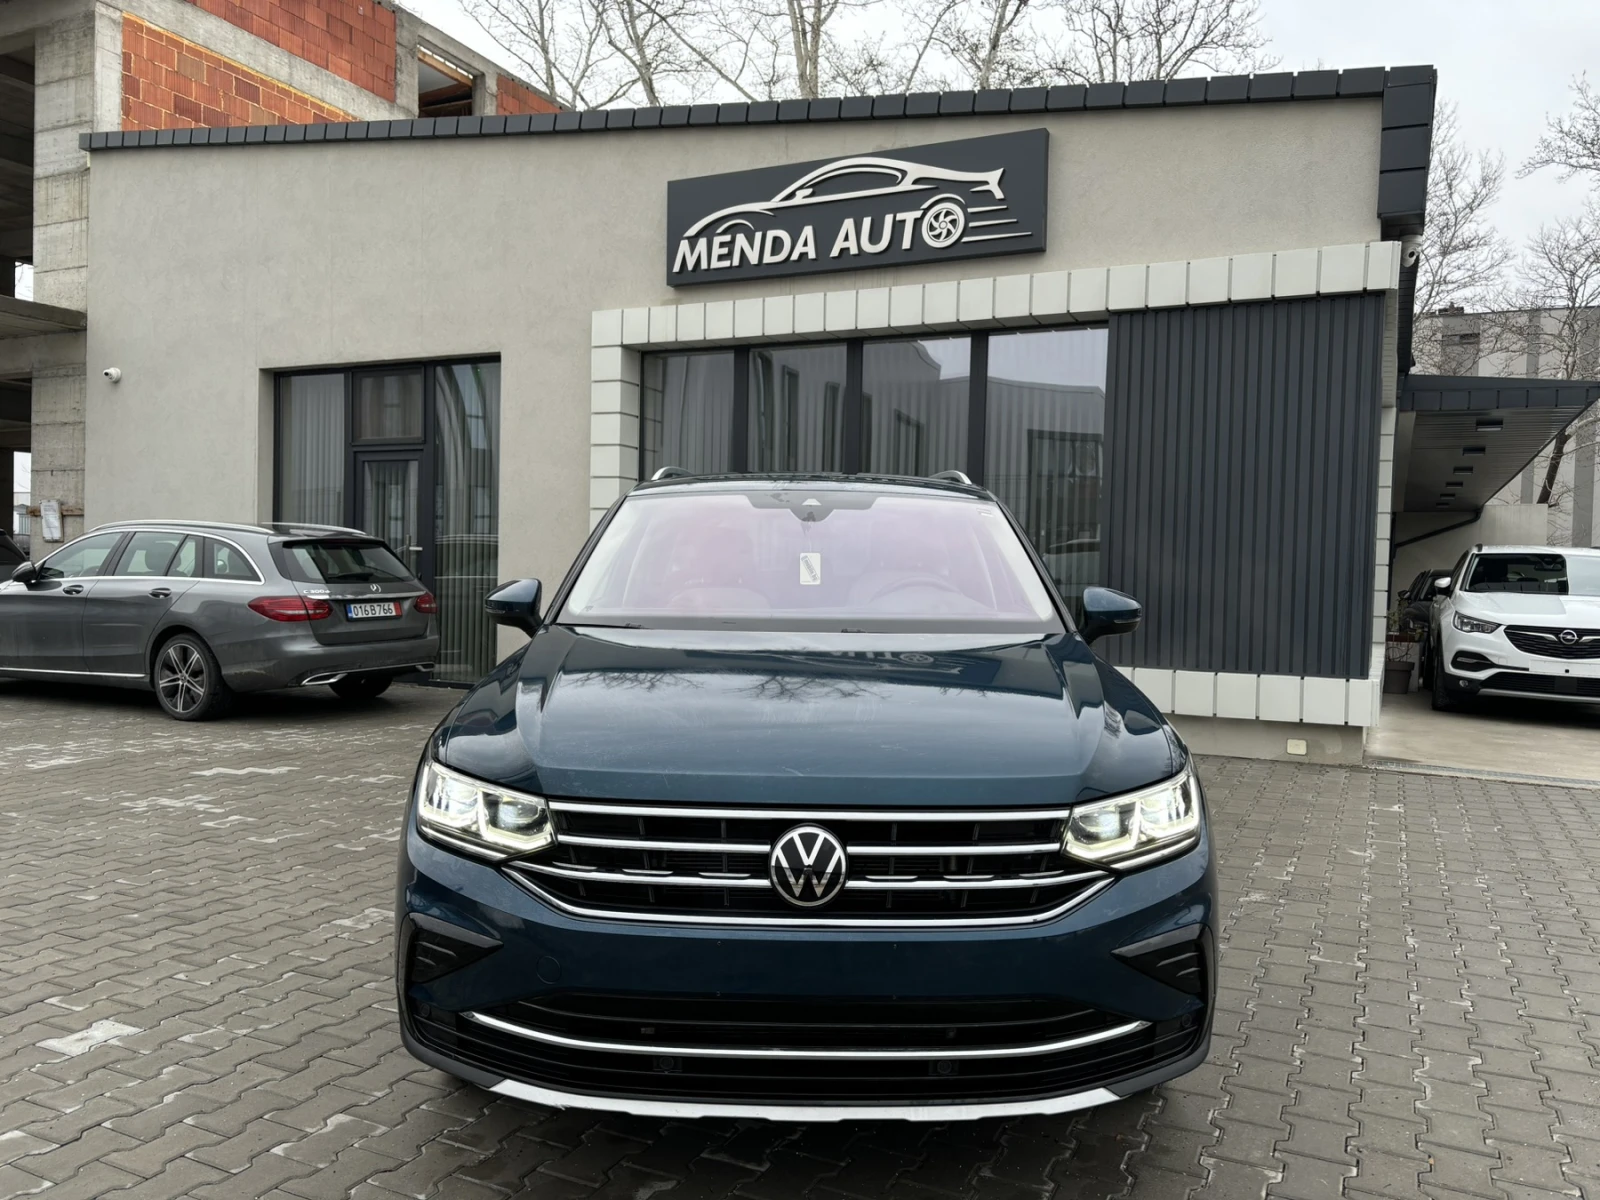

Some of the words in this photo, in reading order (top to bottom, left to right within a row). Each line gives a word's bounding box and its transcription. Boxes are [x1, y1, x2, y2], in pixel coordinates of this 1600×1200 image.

[672, 225, 817, 273] MENDA
[829, 202, 965, 257] AUTO
[352, 603, 394, 617] 016B766
